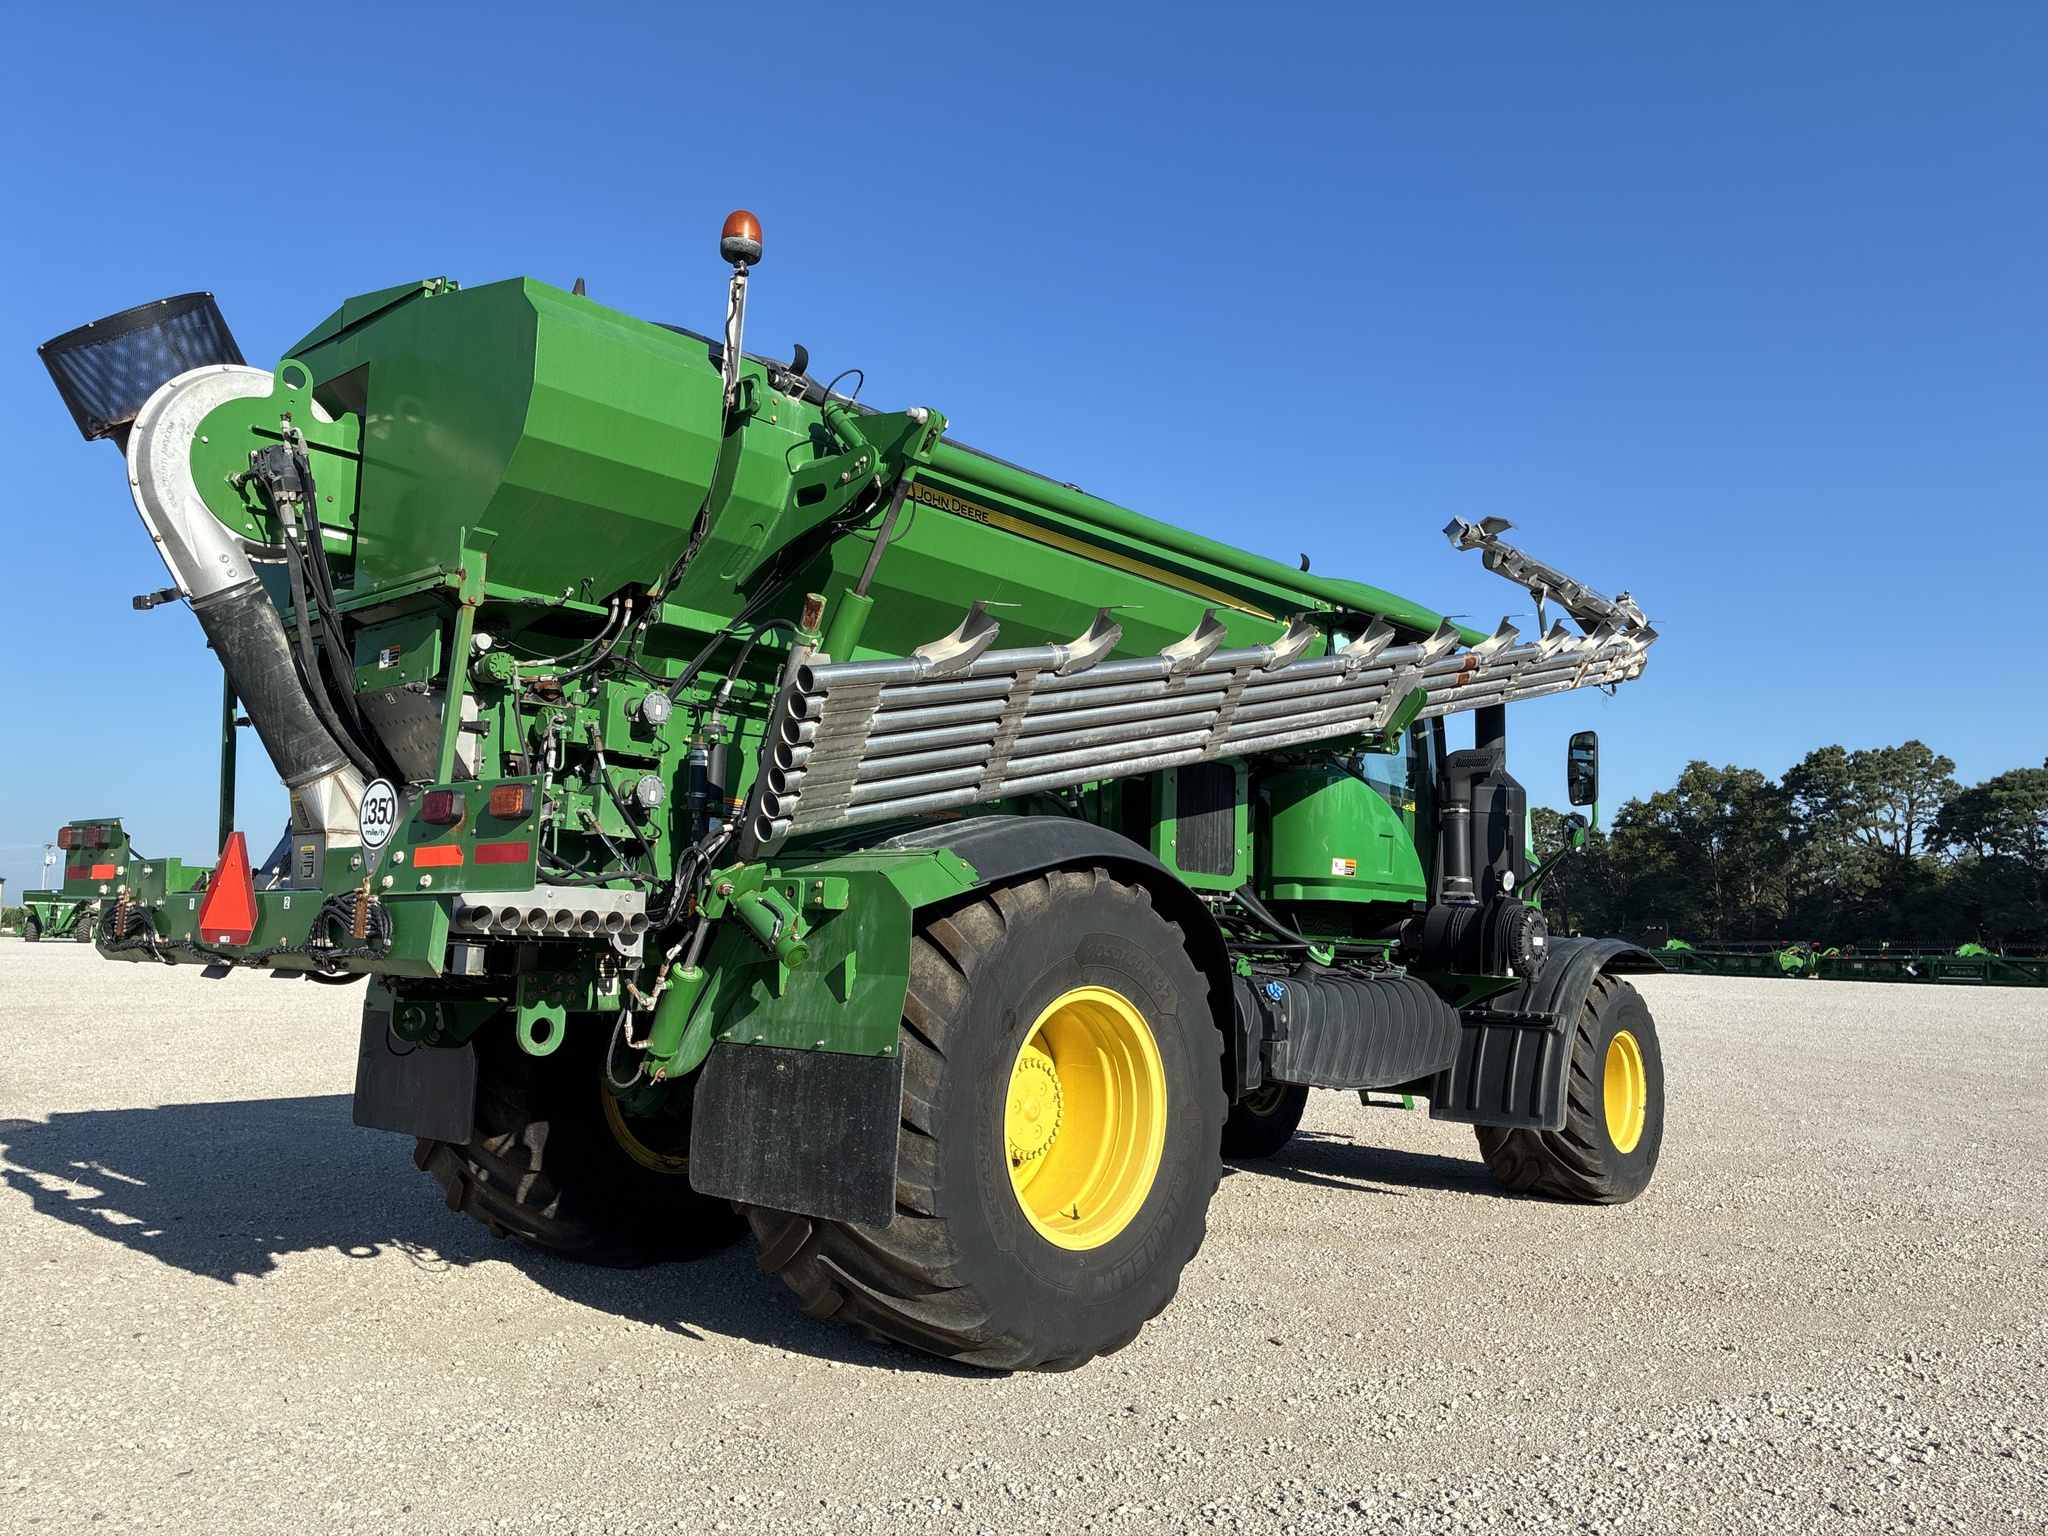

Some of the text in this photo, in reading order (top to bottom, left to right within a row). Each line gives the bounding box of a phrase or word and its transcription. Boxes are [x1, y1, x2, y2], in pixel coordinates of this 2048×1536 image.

[917, 487, 989, 523] JOHN DEERE
[363, 797, 392, 825] 1350
[365, 828, 385, 836] mile/h
[284, 897, 290, 908] 2
